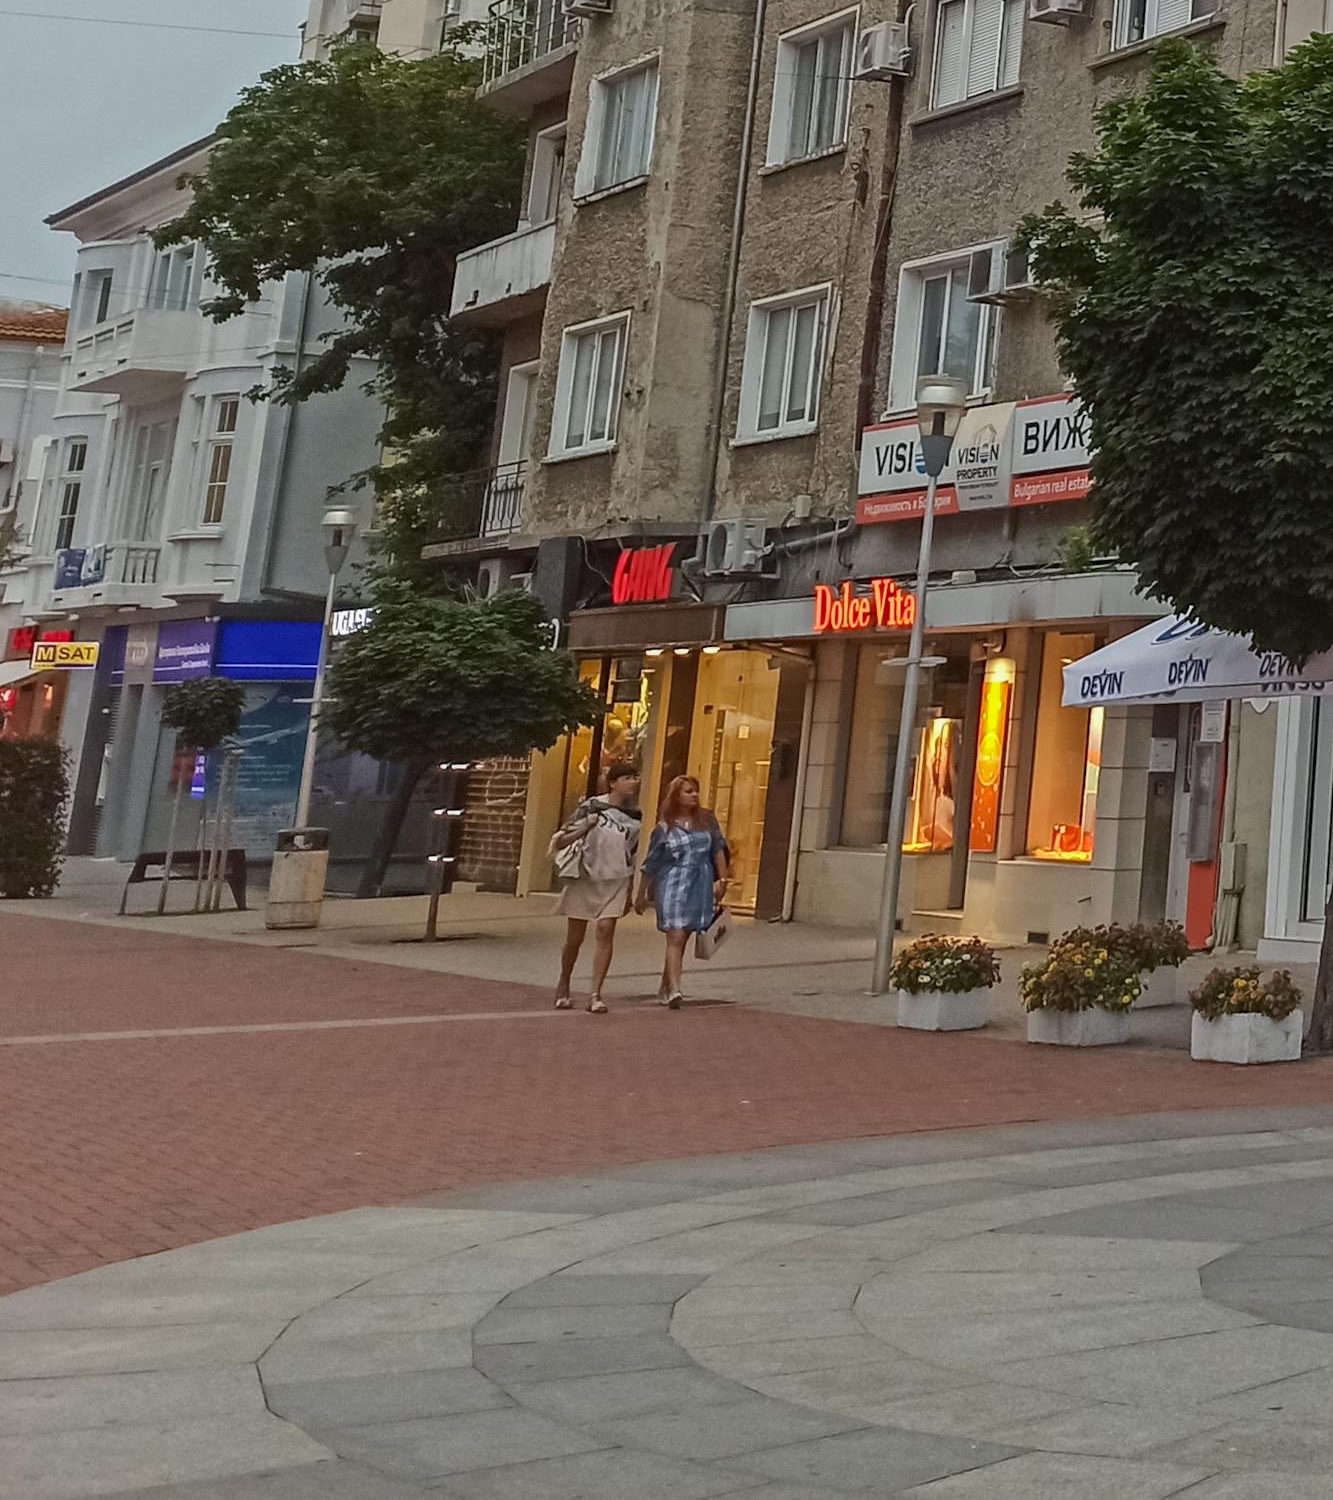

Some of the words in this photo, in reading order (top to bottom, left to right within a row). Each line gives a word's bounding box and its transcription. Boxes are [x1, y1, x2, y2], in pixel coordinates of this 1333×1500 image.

[875, 441, 949, 476] VISI
[958, 444, 999, 464] VISION
[957, 466, 998, 481] PROPERTY
[1014, 481, 1051, 500] Bulgarian
[1052, 476, 1067, 493] real
[1068, 476, 1090, 491] estat
[814, 581, 871, 629] Dolce
[872, 579, 916, 626] Vita
[1081, 670, 1125, 699] DEVIN
[1168, 656, 1212, 685] DEVIN
